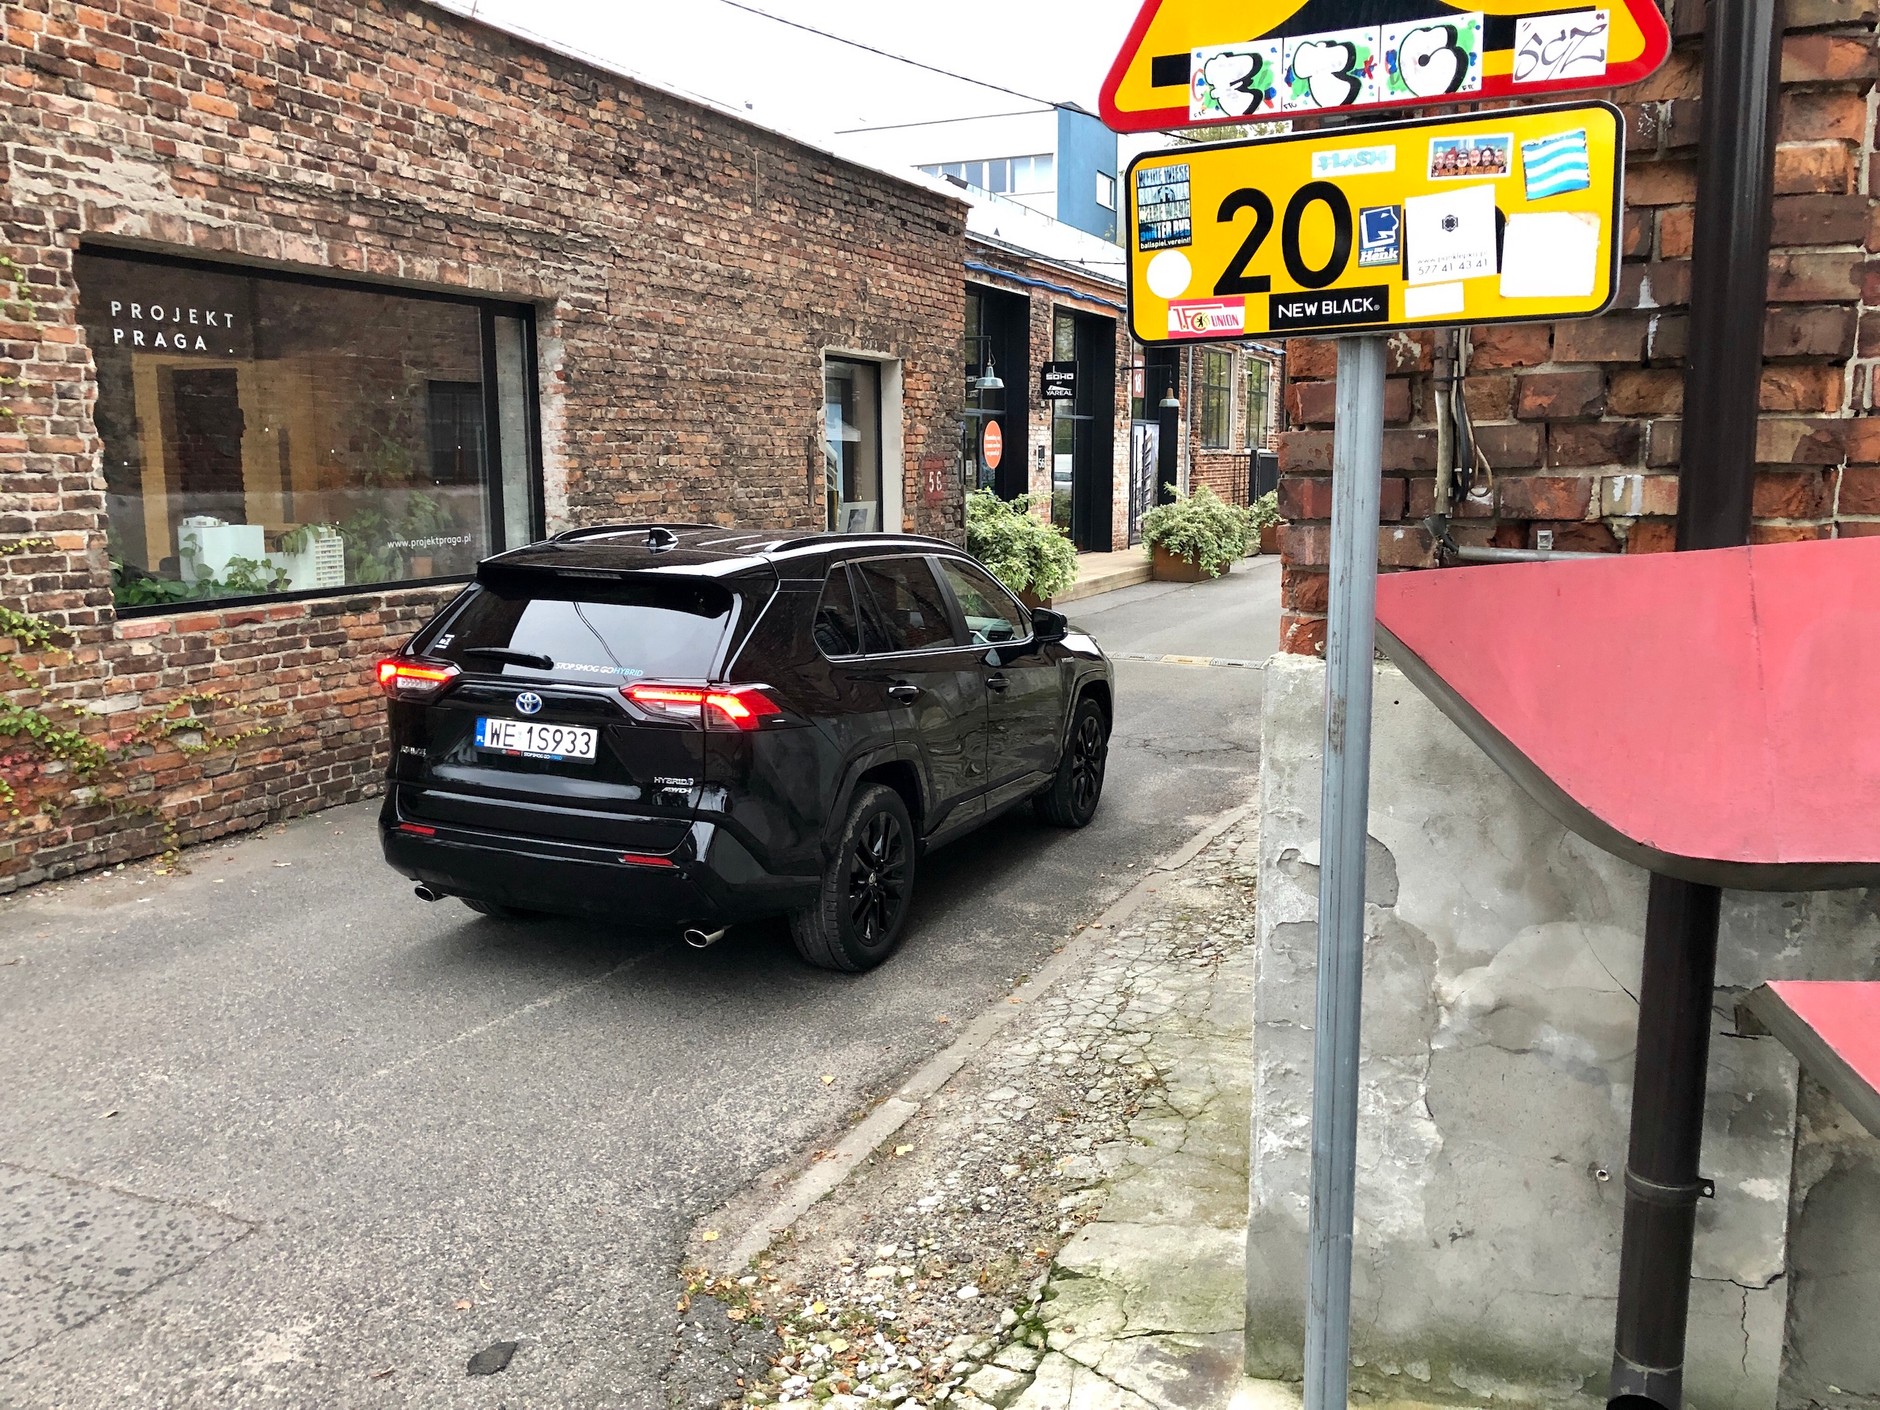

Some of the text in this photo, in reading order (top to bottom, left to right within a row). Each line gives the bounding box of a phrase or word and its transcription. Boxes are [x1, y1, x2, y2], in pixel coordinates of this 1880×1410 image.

[1213, 181, 1353, 296] 20
[1418, 264, 1437, 275] 577
[110, 300, 233, 328] PROJEKT
[1211, 314, 1239, 328] UNION
[1278, 302, 1318, 319] NEW
[113, 328, 207, 351] PRAGA
[929, 471, 942, 493] 56
[387, 533, 472, 549] www.projektpraga.pl
[490, 721, 591, 755] WE 1S933
